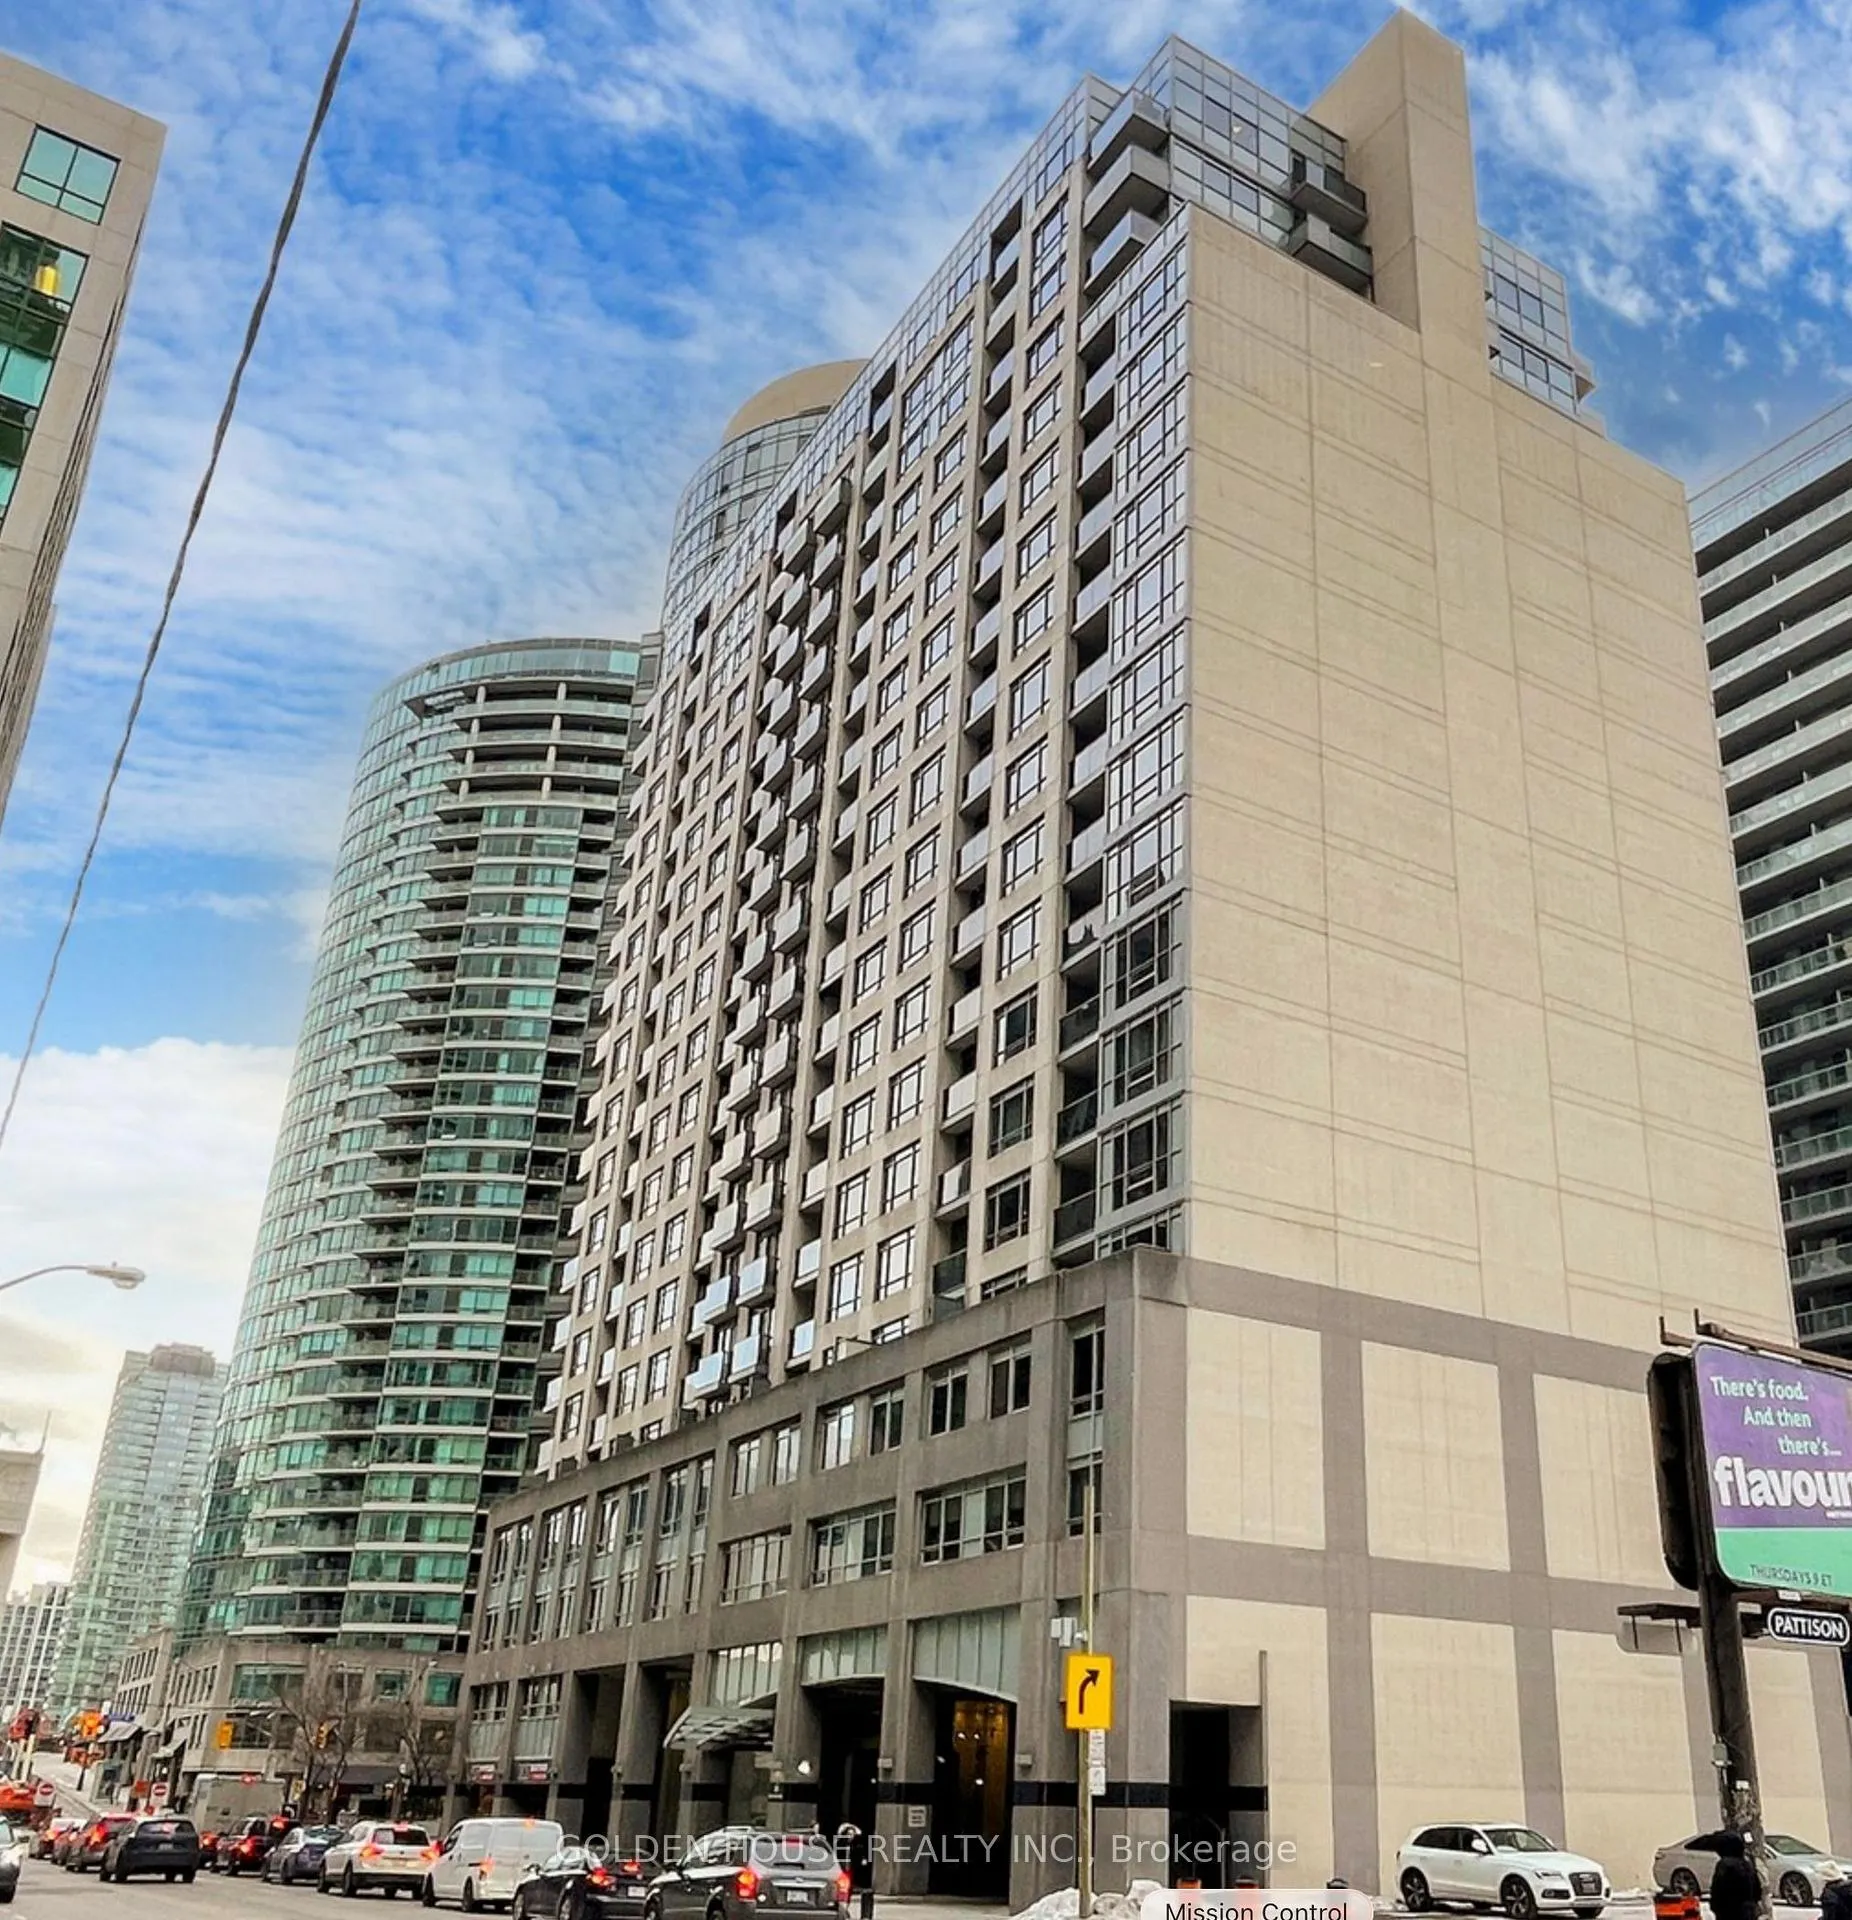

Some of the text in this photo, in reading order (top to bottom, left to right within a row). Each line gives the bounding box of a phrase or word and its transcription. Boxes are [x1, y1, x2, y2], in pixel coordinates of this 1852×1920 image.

[1710, 1376, 1809, 1401] There's food.
[1744, 1406, 1812, 1428] And then
[1749, 1564, 1812, 1585] THURSDAYS
[1821, 1574, 1833, 1588] ET
[1774, 1615, 1845, 1640] PATTISON
